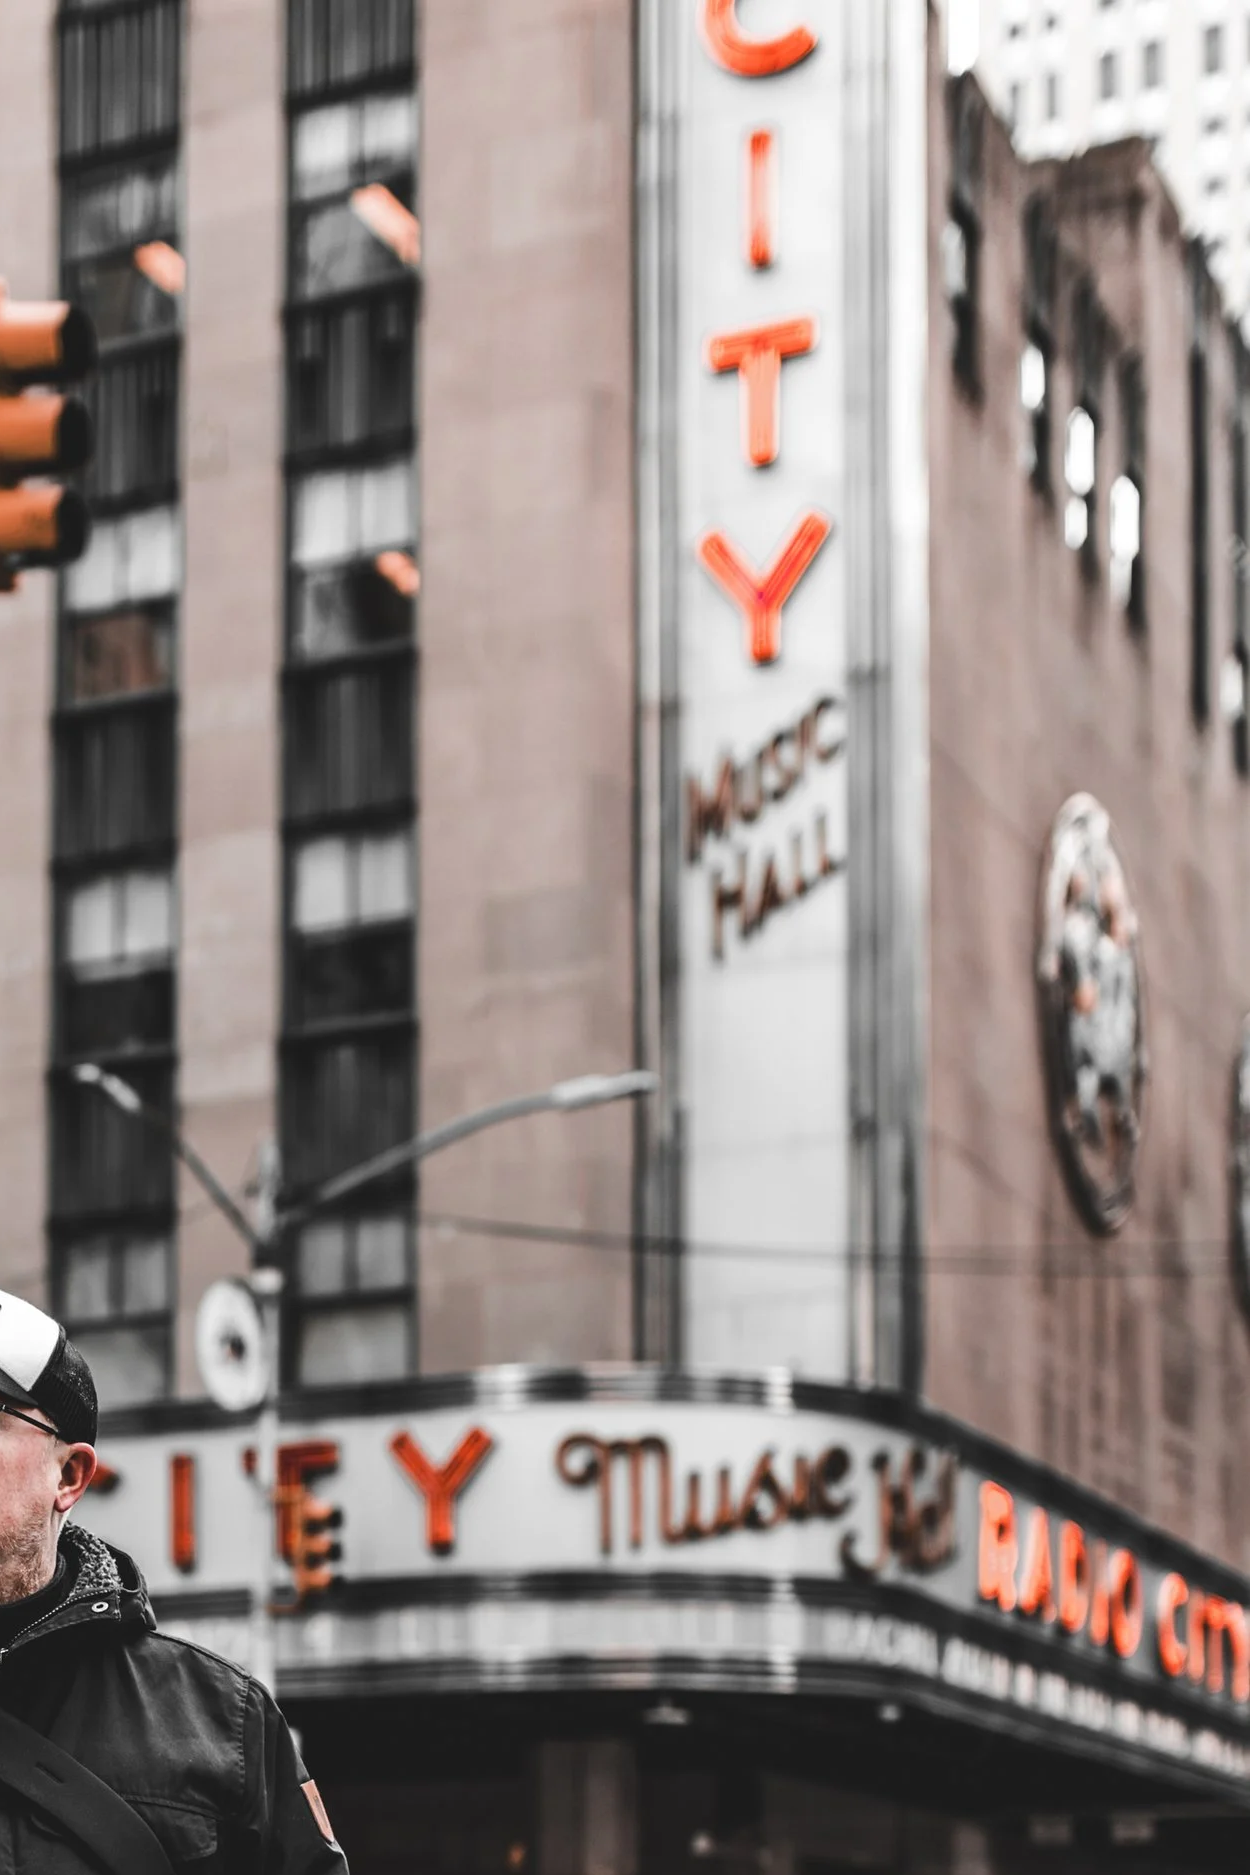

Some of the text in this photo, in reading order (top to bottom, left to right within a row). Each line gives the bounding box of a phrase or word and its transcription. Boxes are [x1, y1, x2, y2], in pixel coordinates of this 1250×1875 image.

[713, 812, 848, 962] HALL
[91, 1425, 495, 1571] ITY
[556, 1431, 854, 1555] Music
[978, 1480, 1143, 1658] RADIO
